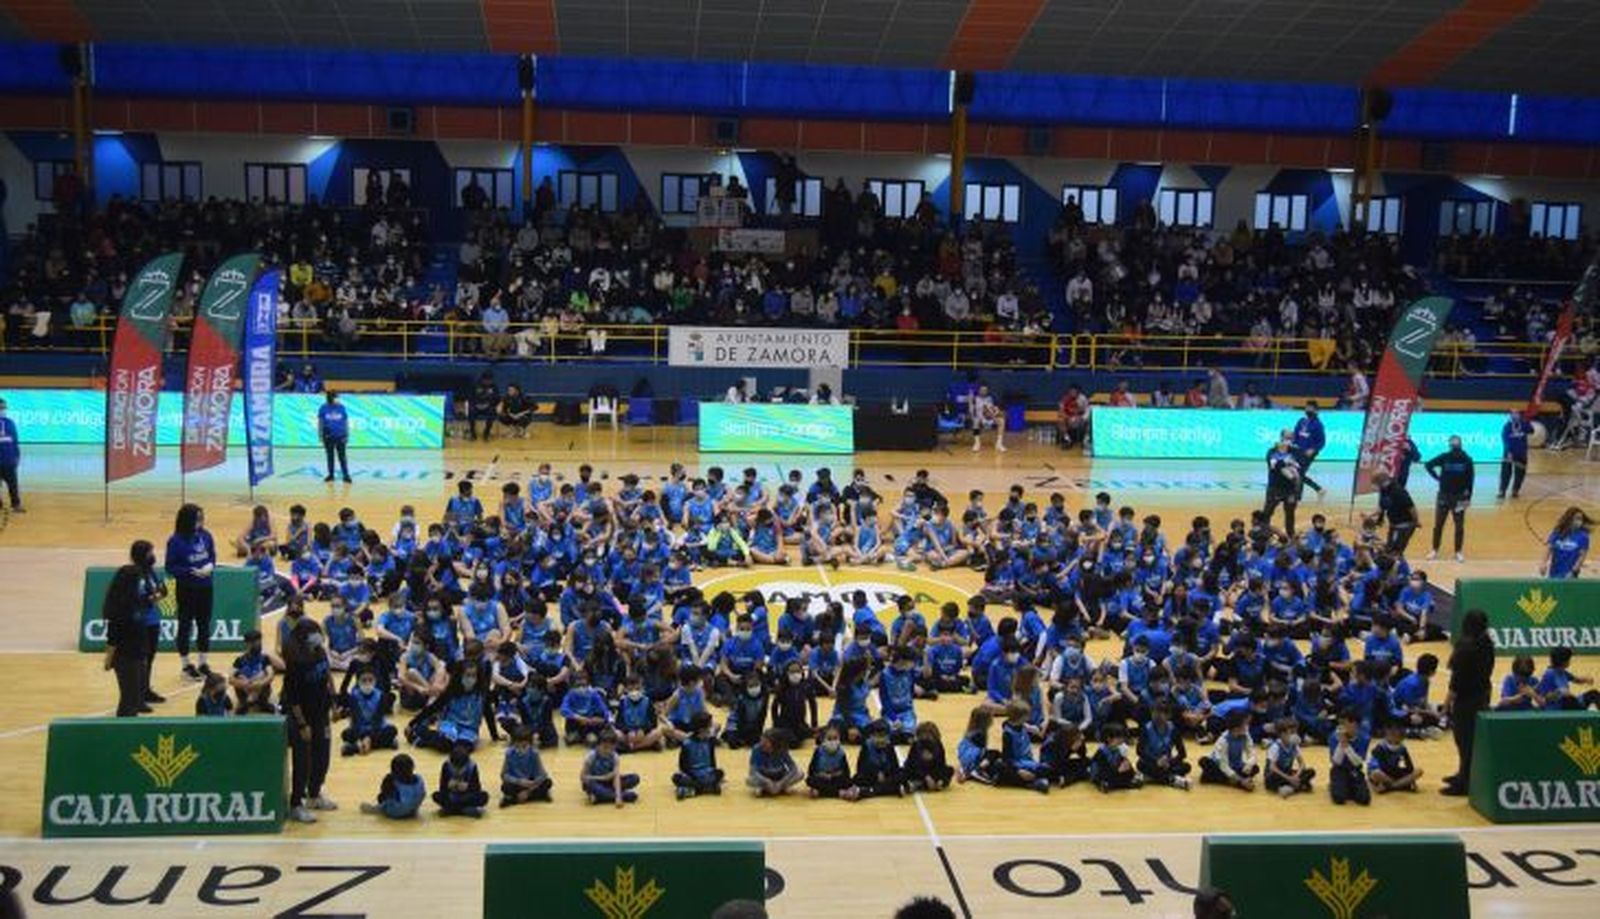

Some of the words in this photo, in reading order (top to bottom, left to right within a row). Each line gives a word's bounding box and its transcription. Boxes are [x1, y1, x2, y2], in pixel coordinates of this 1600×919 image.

[715, 333, 832, 344] AYUNTAMIENTO
[715, 347, 737, 362] DE
[747, 347, 831, 363] ZAMORA
[206, 364, 233, 452] ZAMORA
[250, 346, 271, 442] ZAMORA
[133, 365, 157, 457] ZAMORA
[1486, 627, 1529, 649] AJA
[49, 793, 141, 827] CAJA
[144, 791, 275, 823] RURAL
[1497, 780, 1576, 810] CAJA
